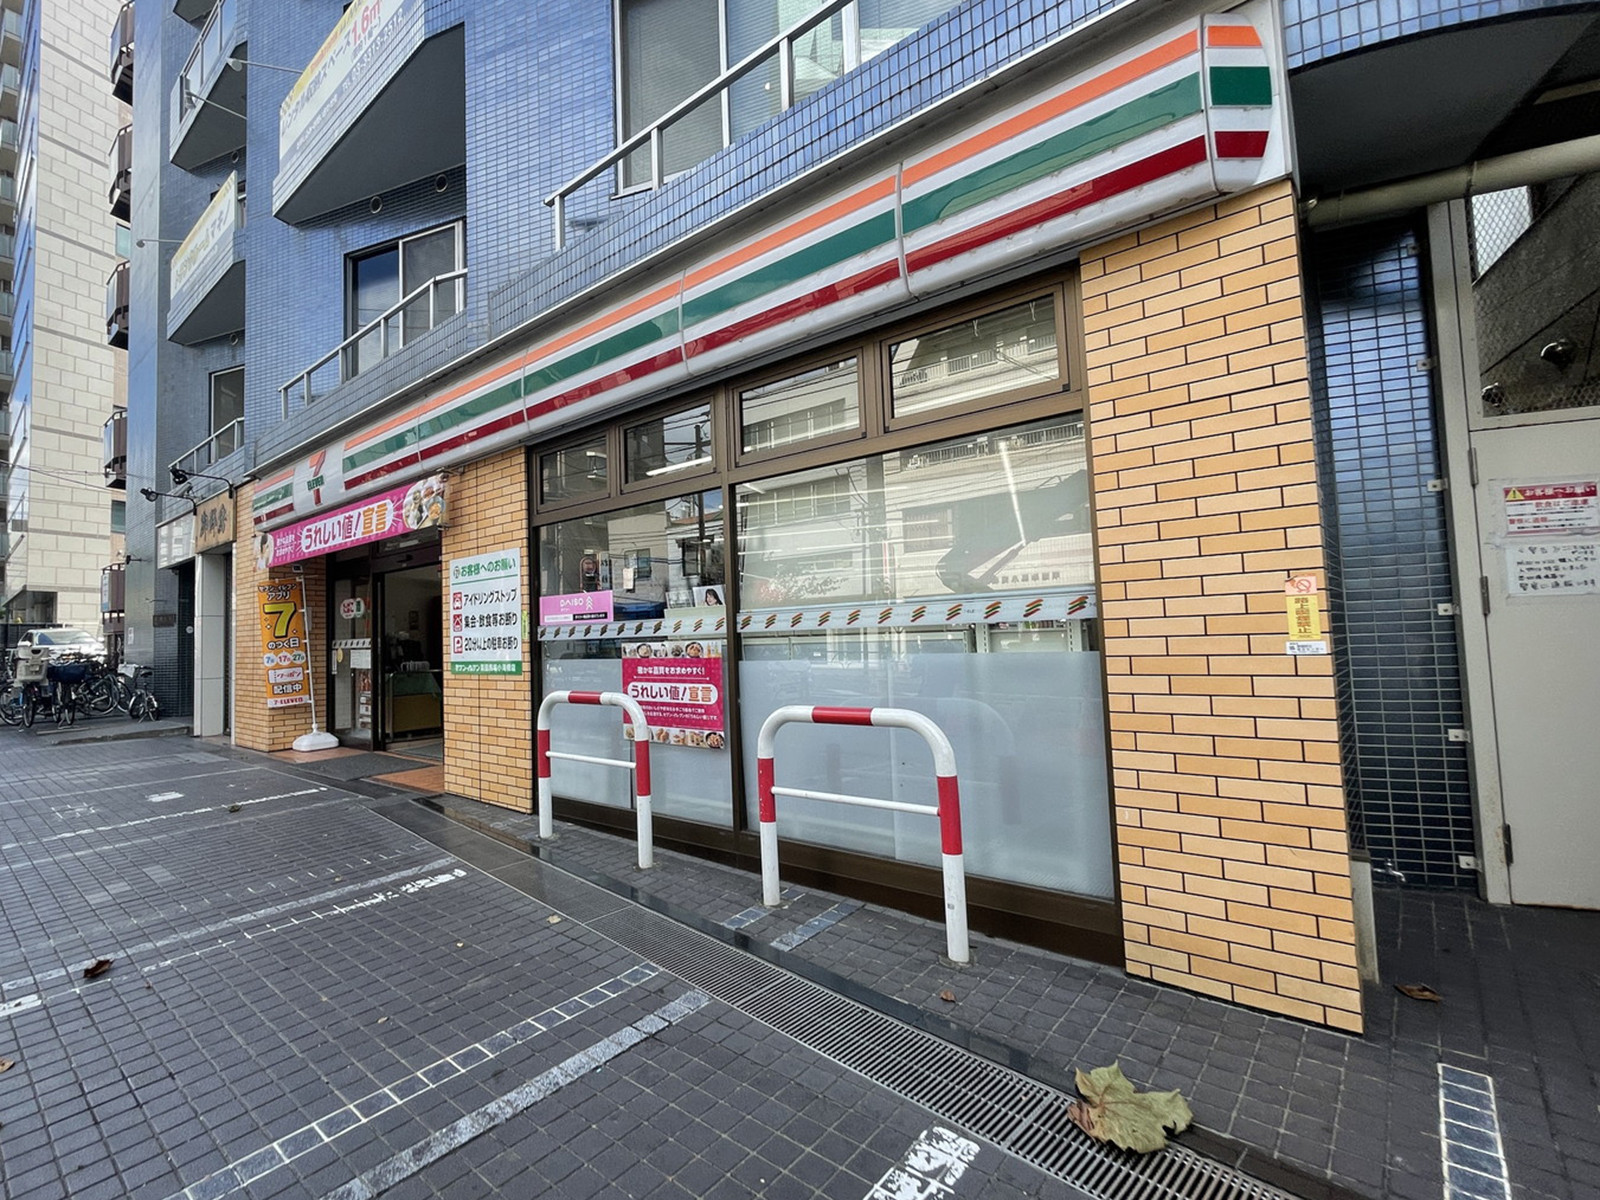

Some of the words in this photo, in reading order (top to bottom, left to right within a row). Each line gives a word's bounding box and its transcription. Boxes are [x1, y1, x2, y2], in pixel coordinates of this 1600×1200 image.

[461, 558, 516, 577] お客様へのお願い
[267, 591, 291, 601] アプリ
[463, 588, 518, 606] アイドリングストップ
[560, 598, 584, 607] DAISO
[263, 602, 298, 639] 7
[267, 637, 300, 650] のつく日
[464, 637, 518, 652] 20分以上の駐車お断り
[273, 682, 302, 695] 配信中
[631, 685, 712, 702] うれしい値!宣言
